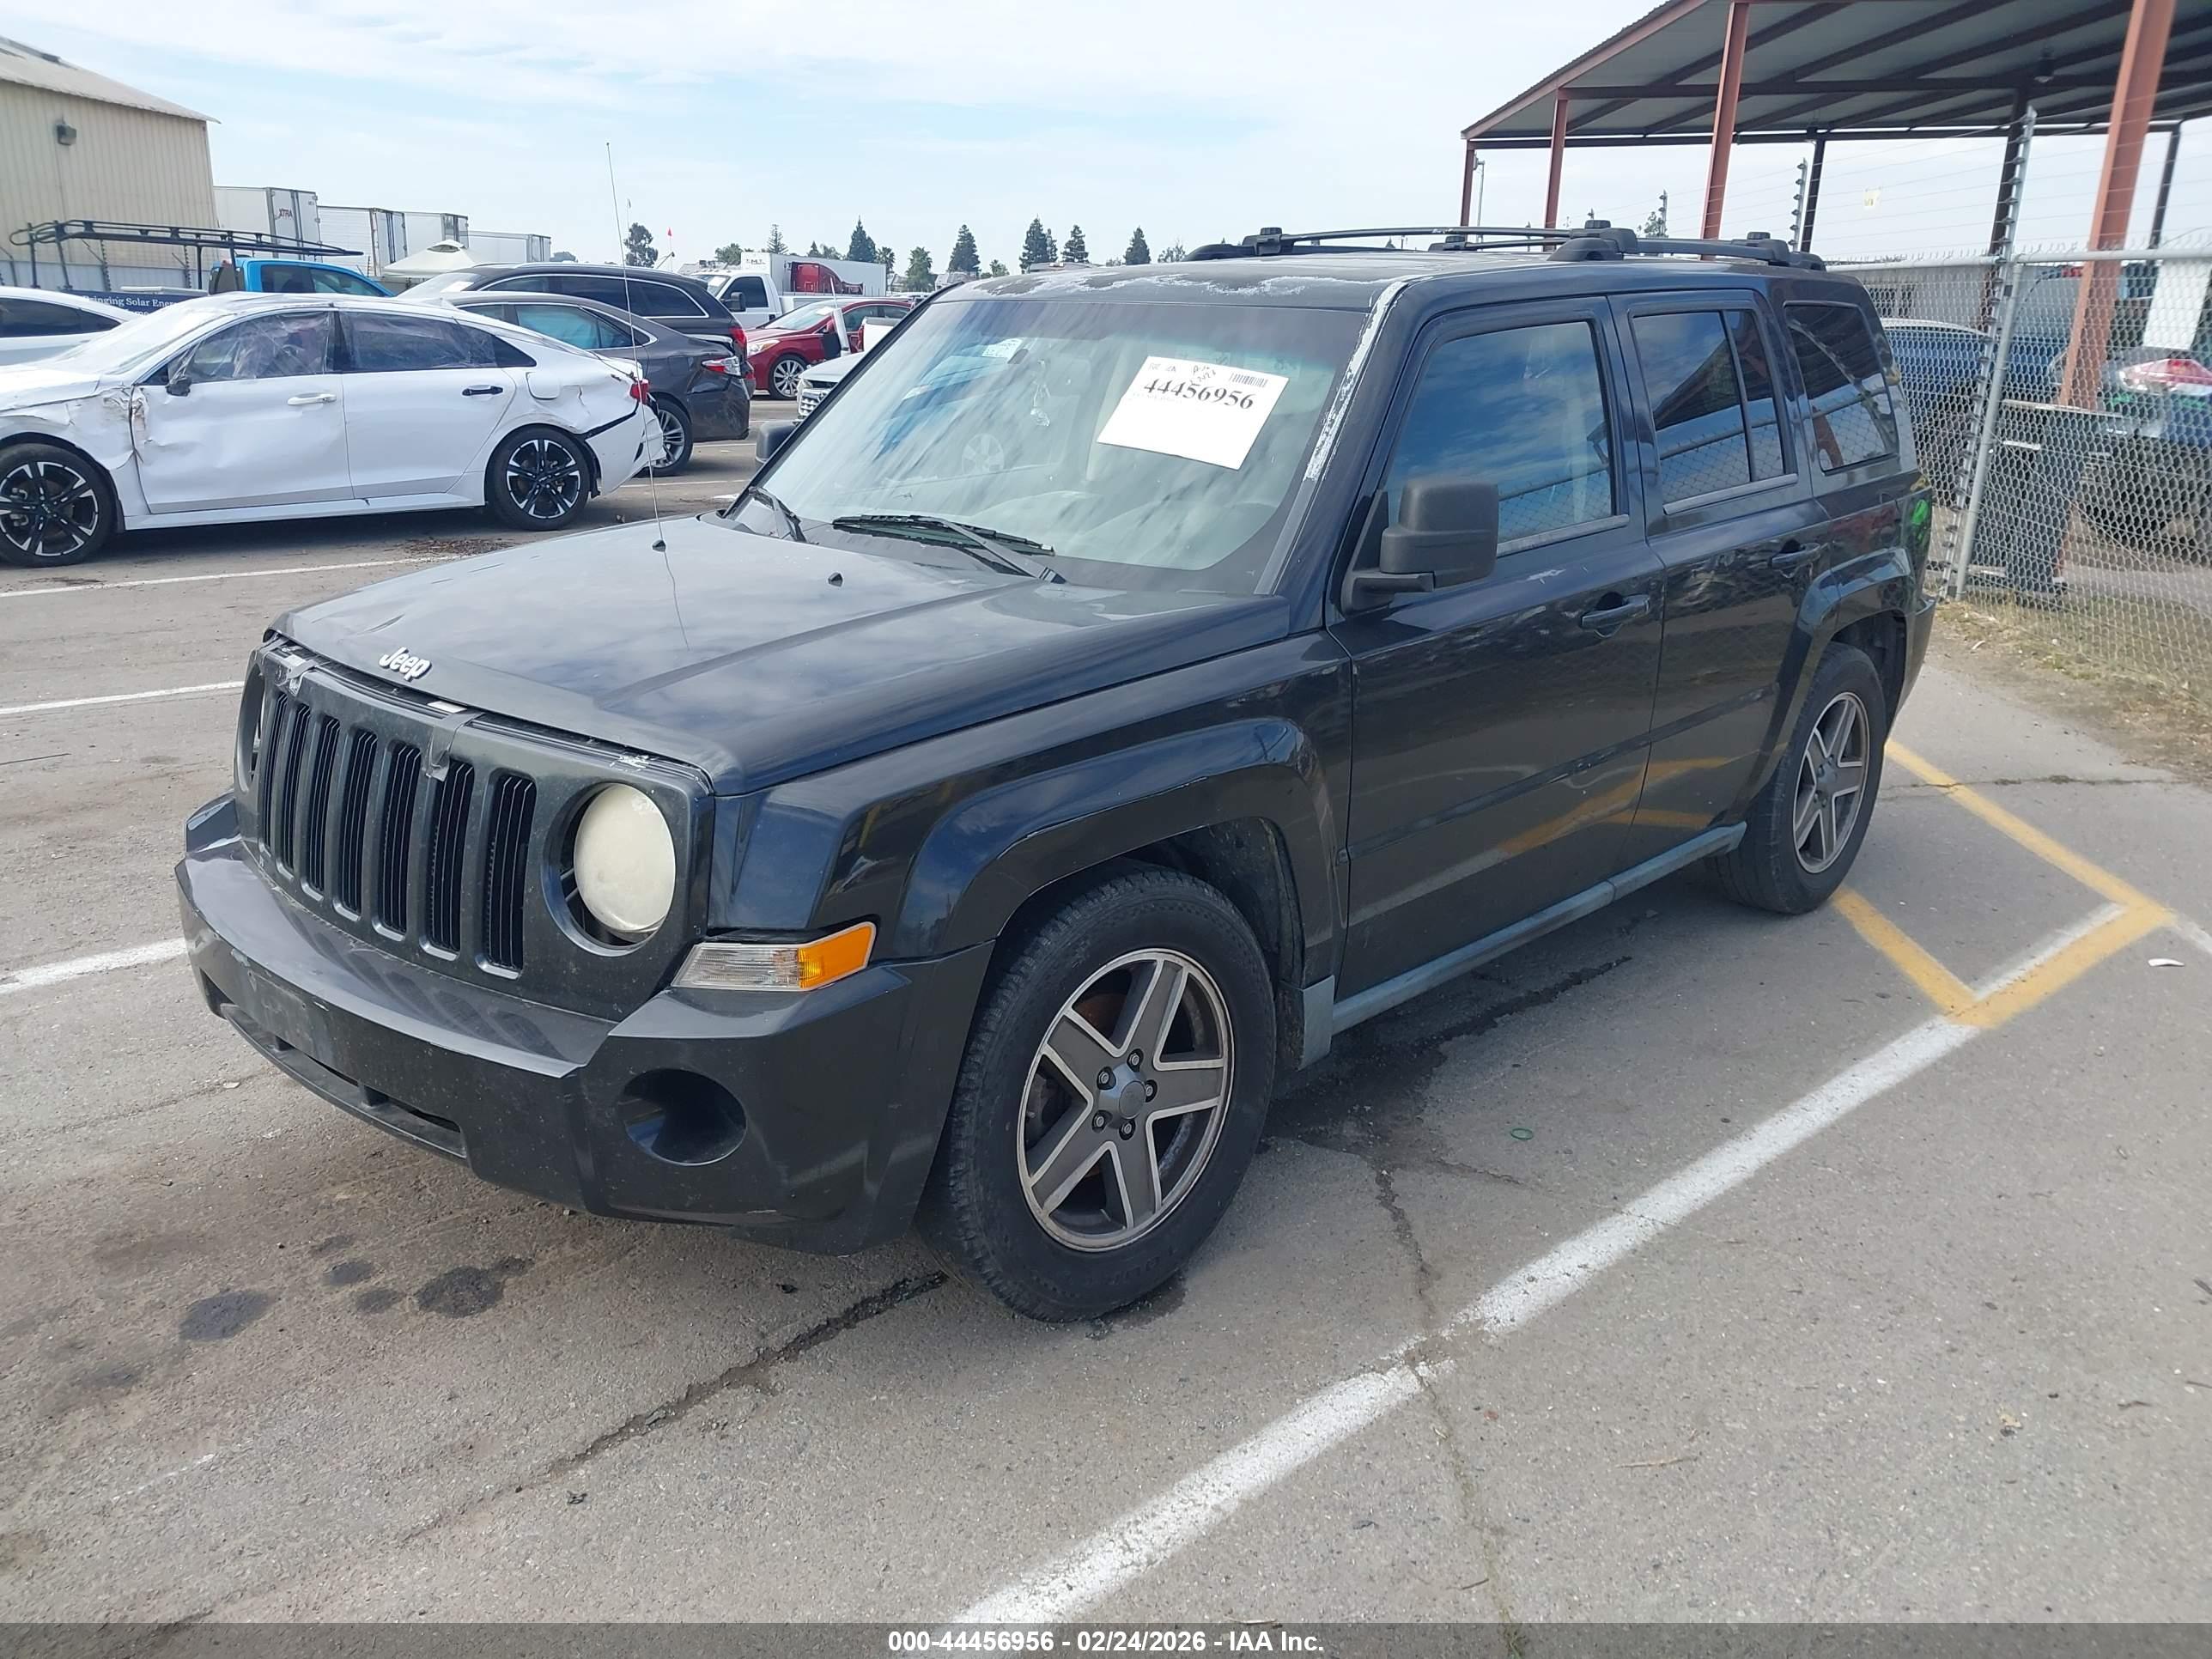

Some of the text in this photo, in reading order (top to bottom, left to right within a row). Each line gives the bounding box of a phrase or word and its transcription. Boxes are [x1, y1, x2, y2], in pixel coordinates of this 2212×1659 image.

[125, 296, 149, 307] Solar
[1144, 378, 1256, 410] 44456956
[380, 647, 431, 681] Jeep
